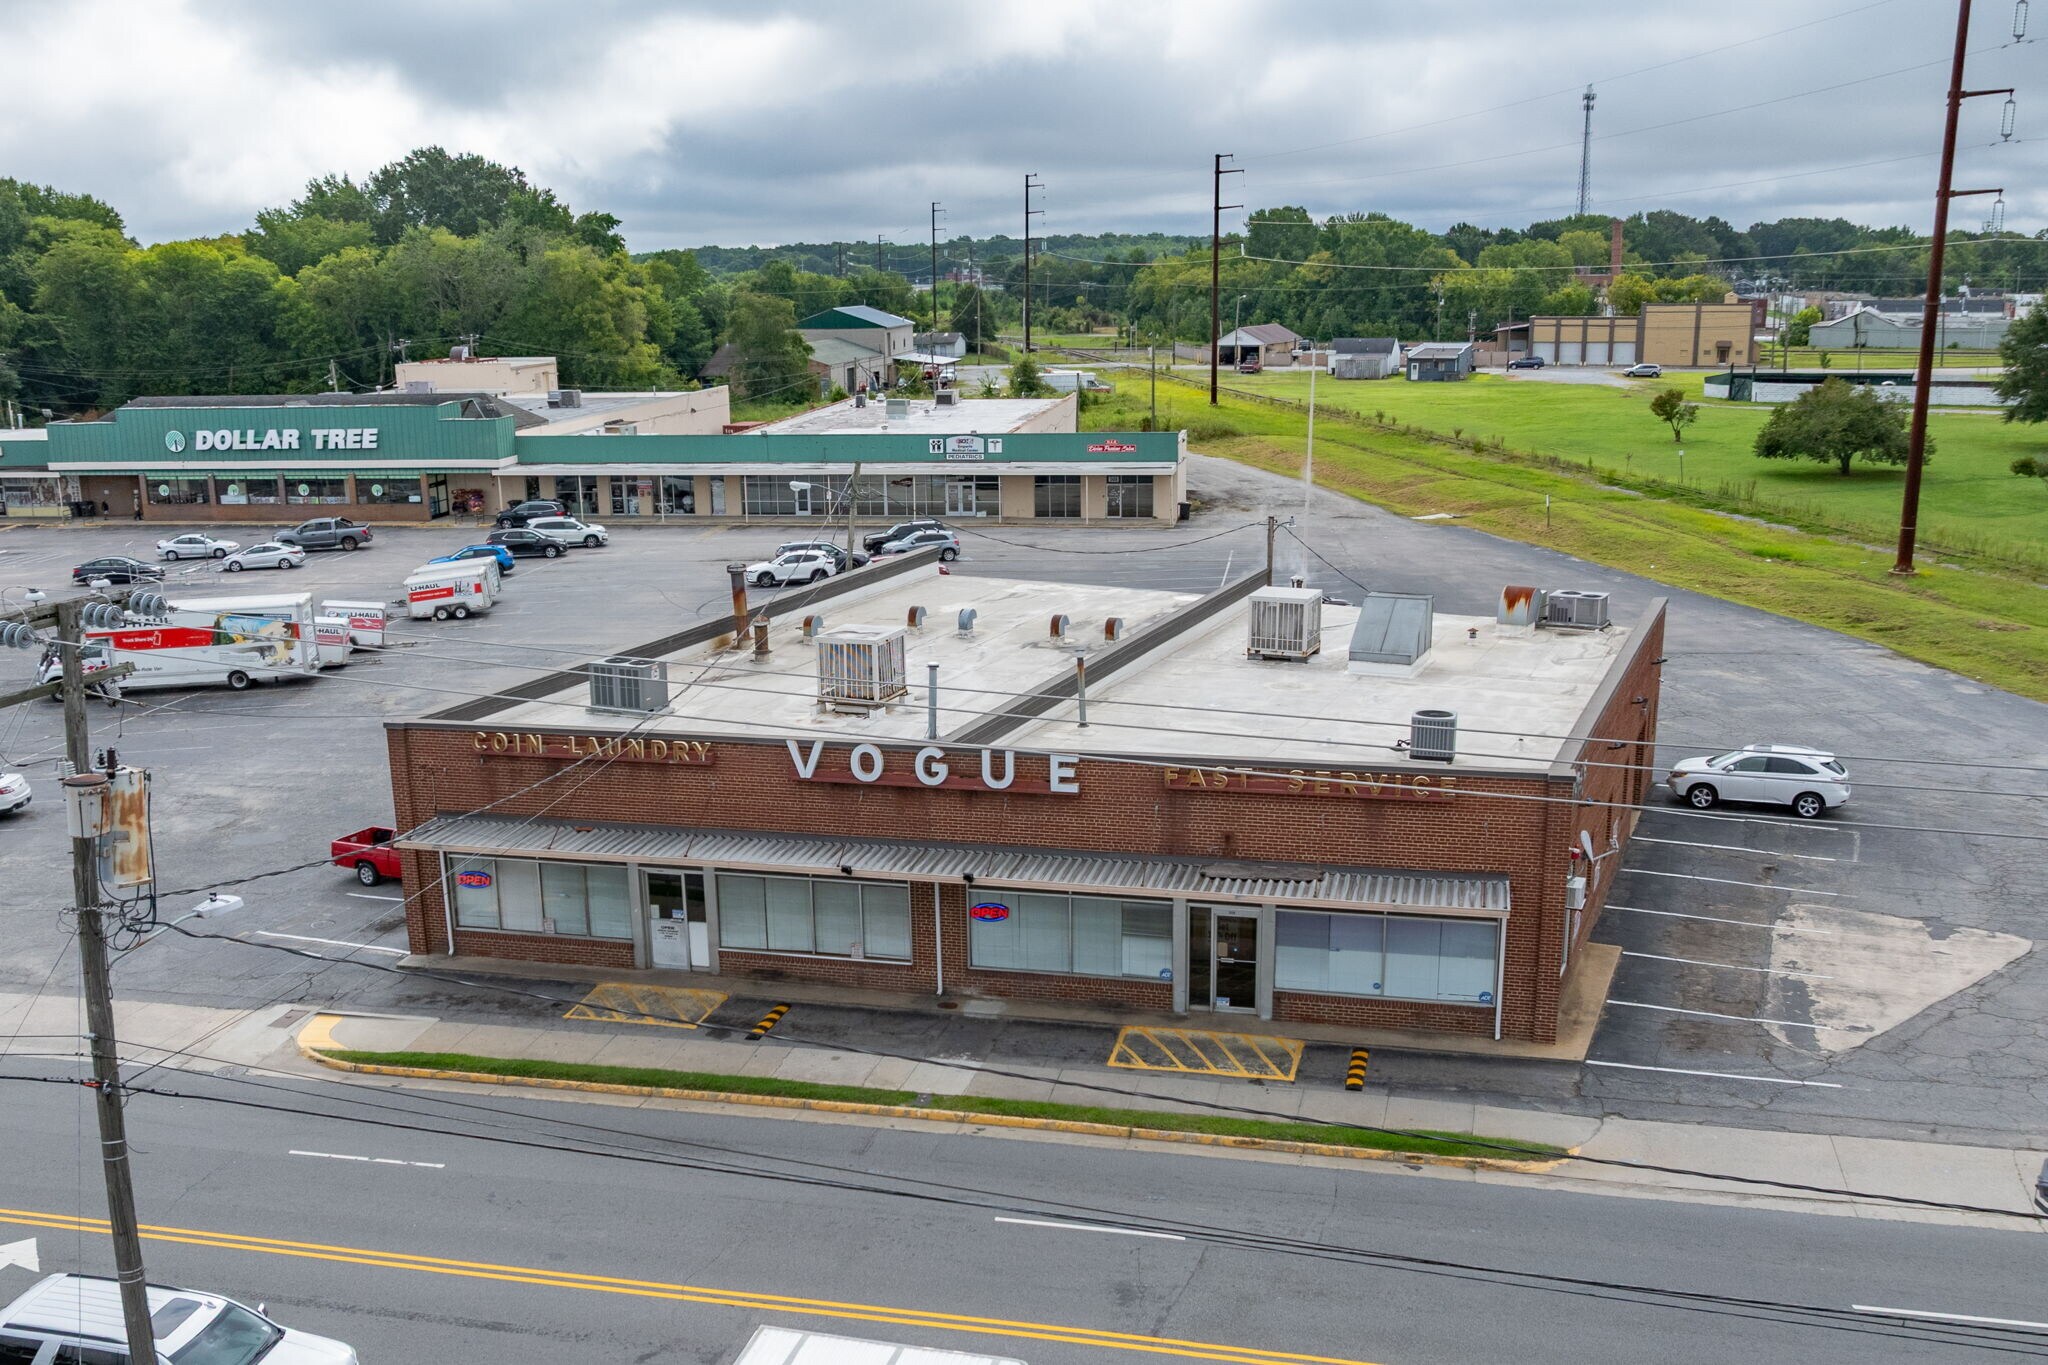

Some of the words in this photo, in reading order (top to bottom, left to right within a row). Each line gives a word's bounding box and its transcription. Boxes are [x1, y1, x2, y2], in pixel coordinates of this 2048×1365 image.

[195, 429, 300, 451] DOLLAR
[311, 428, 379, 450] TREE
[410, 583, 440, 592] U-HAUL
[471, 731, 543, 755] COIN
[567, 735, 712, 762] LAUNDRY
[786, 739, 1080, 794] VOGUE
[1164, 766, 1253, 789] FAST
[1286, 769, 1457, 798] SERVICE
[455, 874, 491, 887] OPEN
[970, 906, 1009, 919] OPEN
